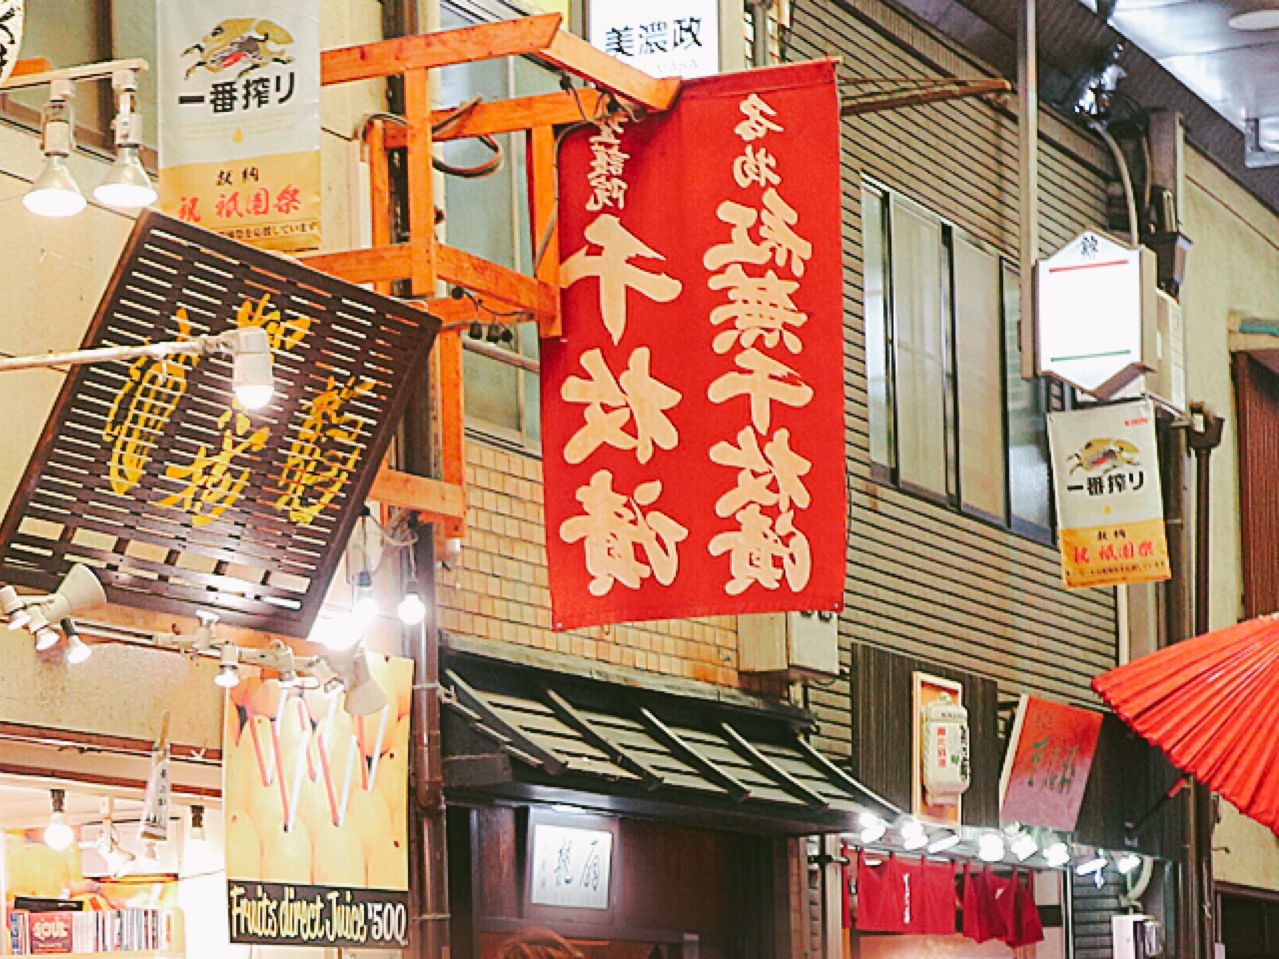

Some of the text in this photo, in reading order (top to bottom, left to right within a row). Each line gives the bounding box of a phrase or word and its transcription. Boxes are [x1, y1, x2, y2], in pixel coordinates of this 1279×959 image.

[178, 72, 295, 113] 一番搾り
[1066, 471, 1145, 495] 一番搾り
[229, 885, 278, 938] Fruits
